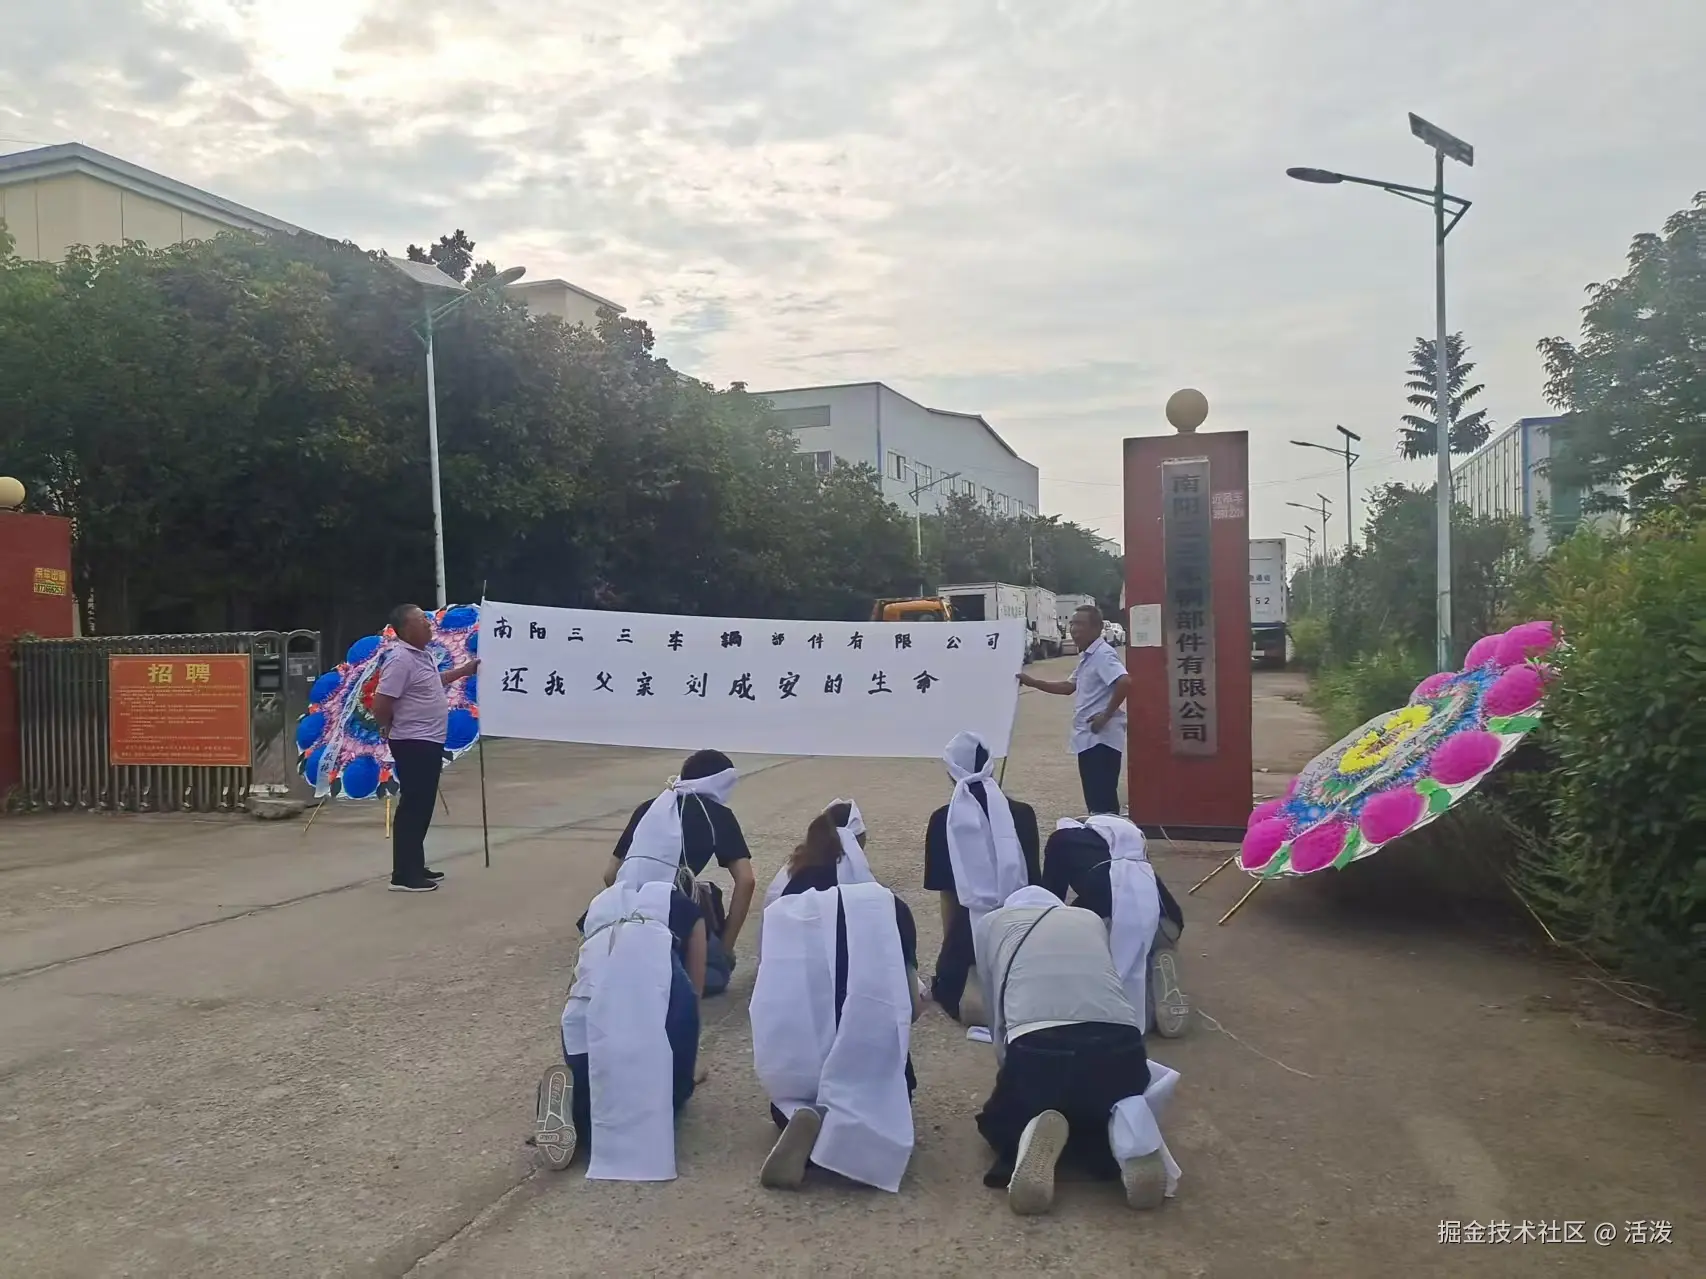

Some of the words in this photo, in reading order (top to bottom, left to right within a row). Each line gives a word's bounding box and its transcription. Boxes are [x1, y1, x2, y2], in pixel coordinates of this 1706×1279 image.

[147, 662, 212, 684] 招聘
[501, 666, 940, 701] 还我父亲刘成安的生命
